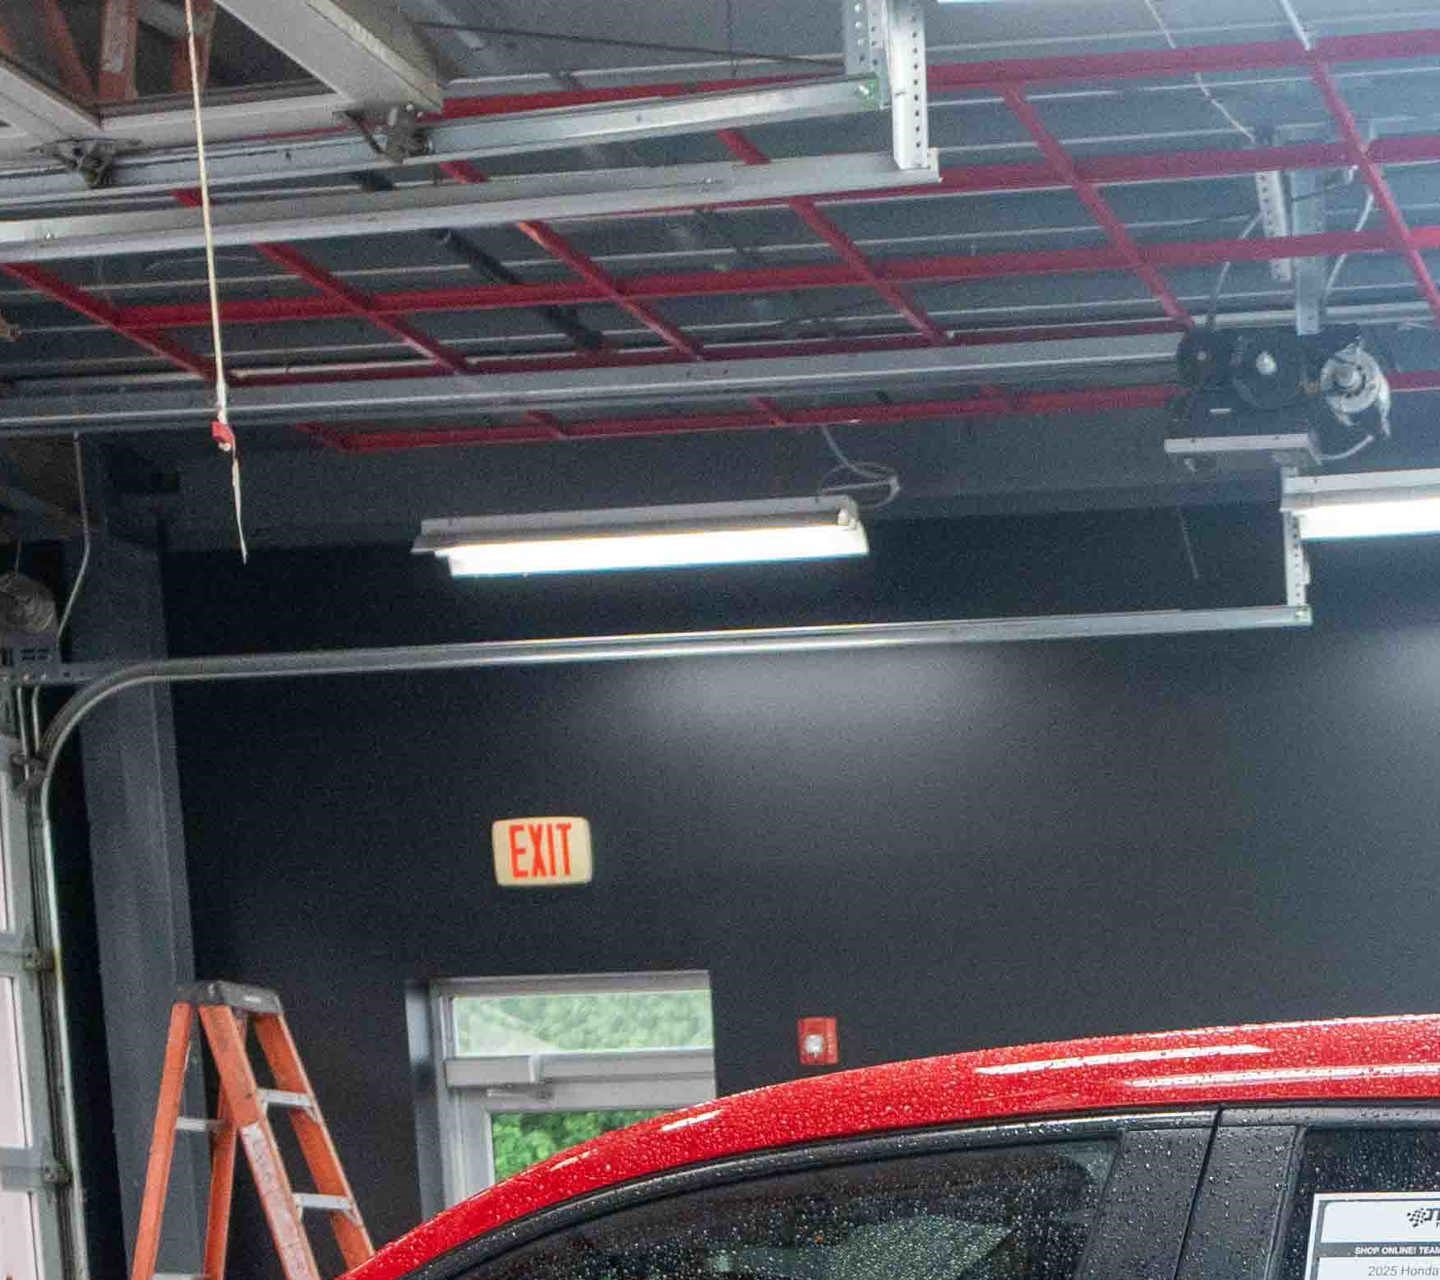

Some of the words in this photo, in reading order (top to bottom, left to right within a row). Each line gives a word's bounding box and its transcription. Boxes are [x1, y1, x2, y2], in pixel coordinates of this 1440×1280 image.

[509, 822, 572, 878] EXIT
[1355, 1246, 1380, 1255] SHOP
[1381, 1246, 1417, 1255] ONLINE!
[1368, 1265, 1397, 1277] 2025
[1400, 1265, 1439, 1277] Honda
